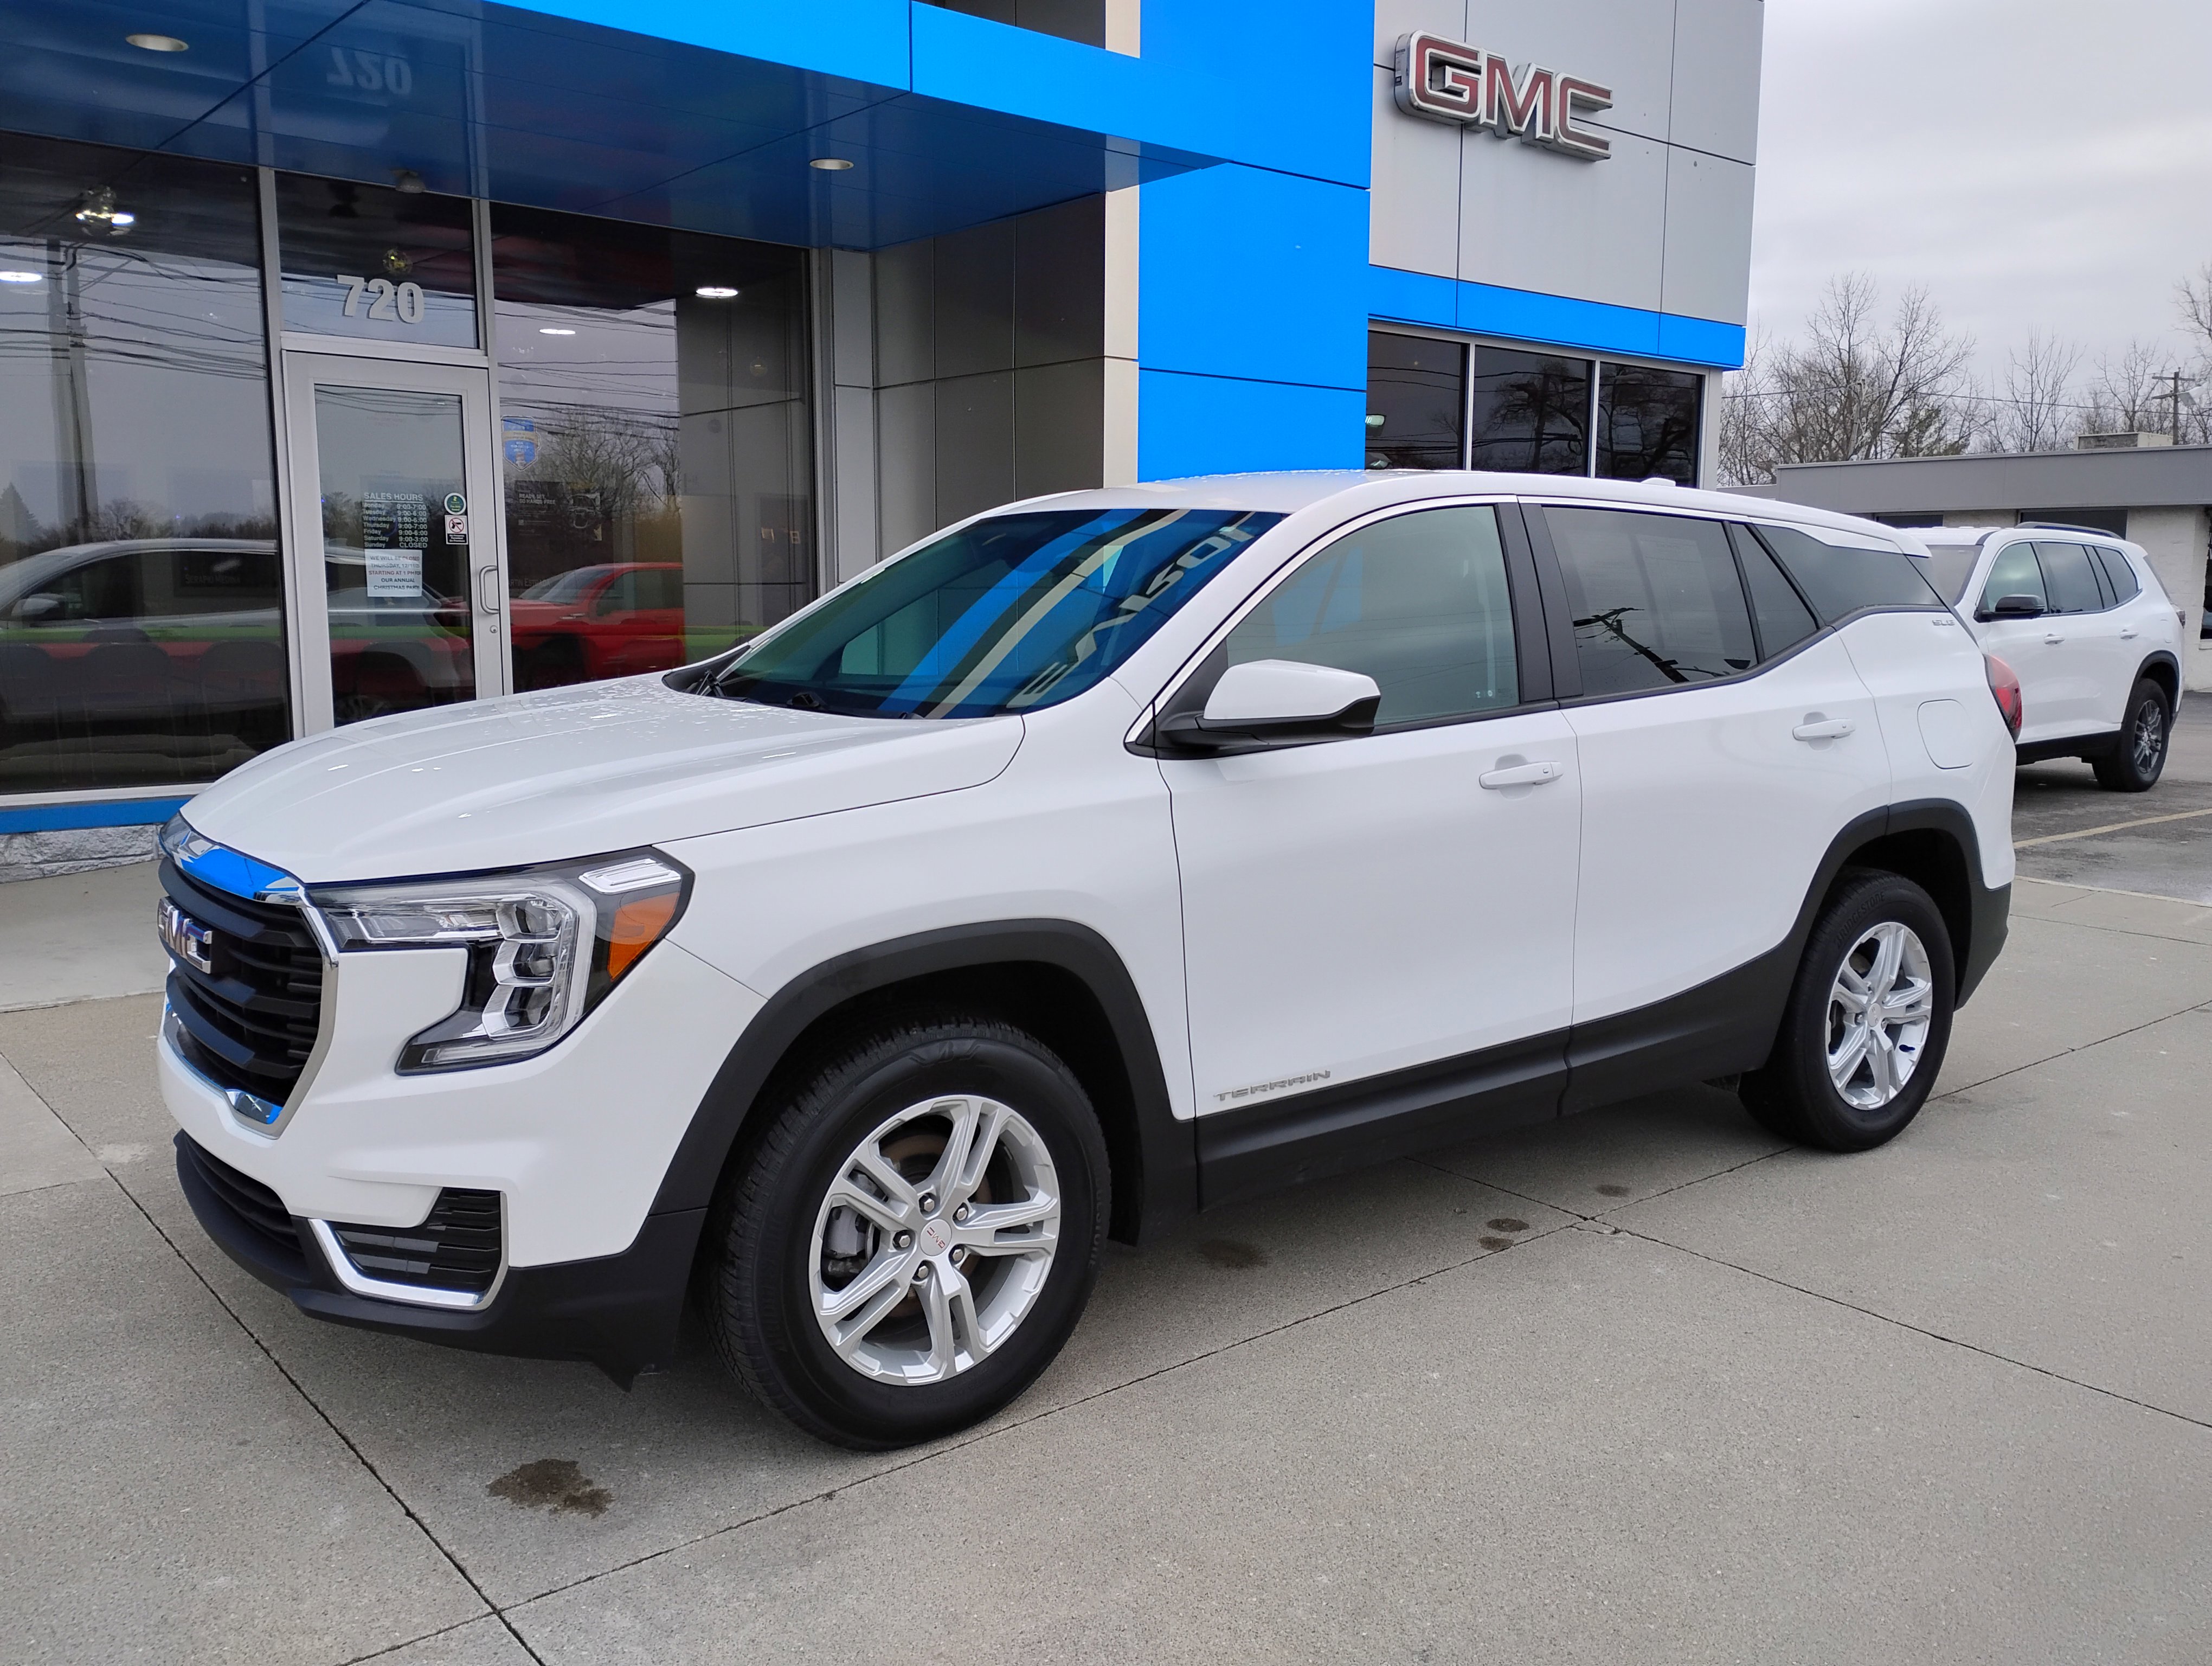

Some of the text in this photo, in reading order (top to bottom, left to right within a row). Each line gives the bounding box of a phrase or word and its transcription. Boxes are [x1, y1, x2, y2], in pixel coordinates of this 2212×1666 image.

[1395, 30, 1613, 162] GMC
[337, 274, 425, 324] 720
[1213, 1069, 1332, 1101] TERRAIN
[927, 1227, 946, 1249] GMC
